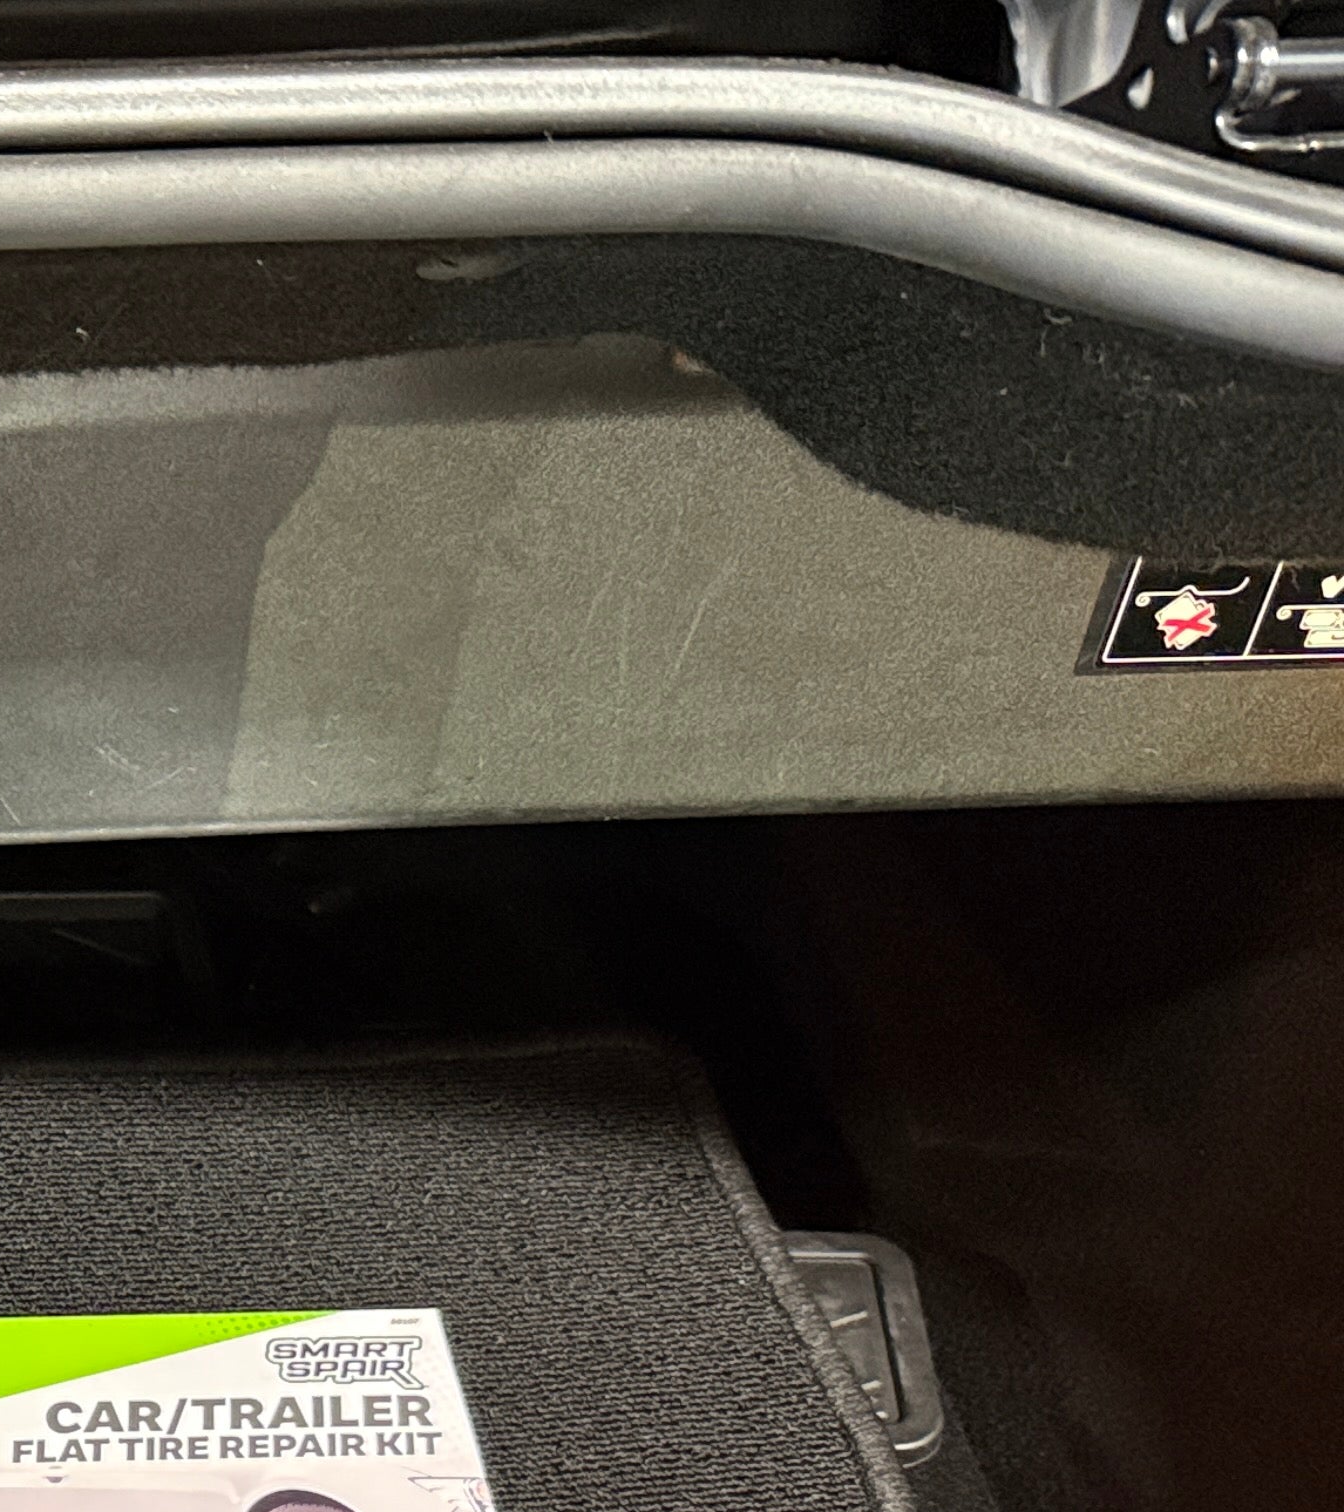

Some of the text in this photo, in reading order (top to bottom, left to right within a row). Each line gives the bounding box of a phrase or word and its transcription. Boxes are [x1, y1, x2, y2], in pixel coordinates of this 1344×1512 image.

[273, 1341, 414, 1359] SMART
[286, 1359, 414, 1385] SPAIR
[45, 1394, 433, 1435] CAR/TRAILER
[12, 1431, 443, 1464] FLAT TIRE REPAIR KIT
